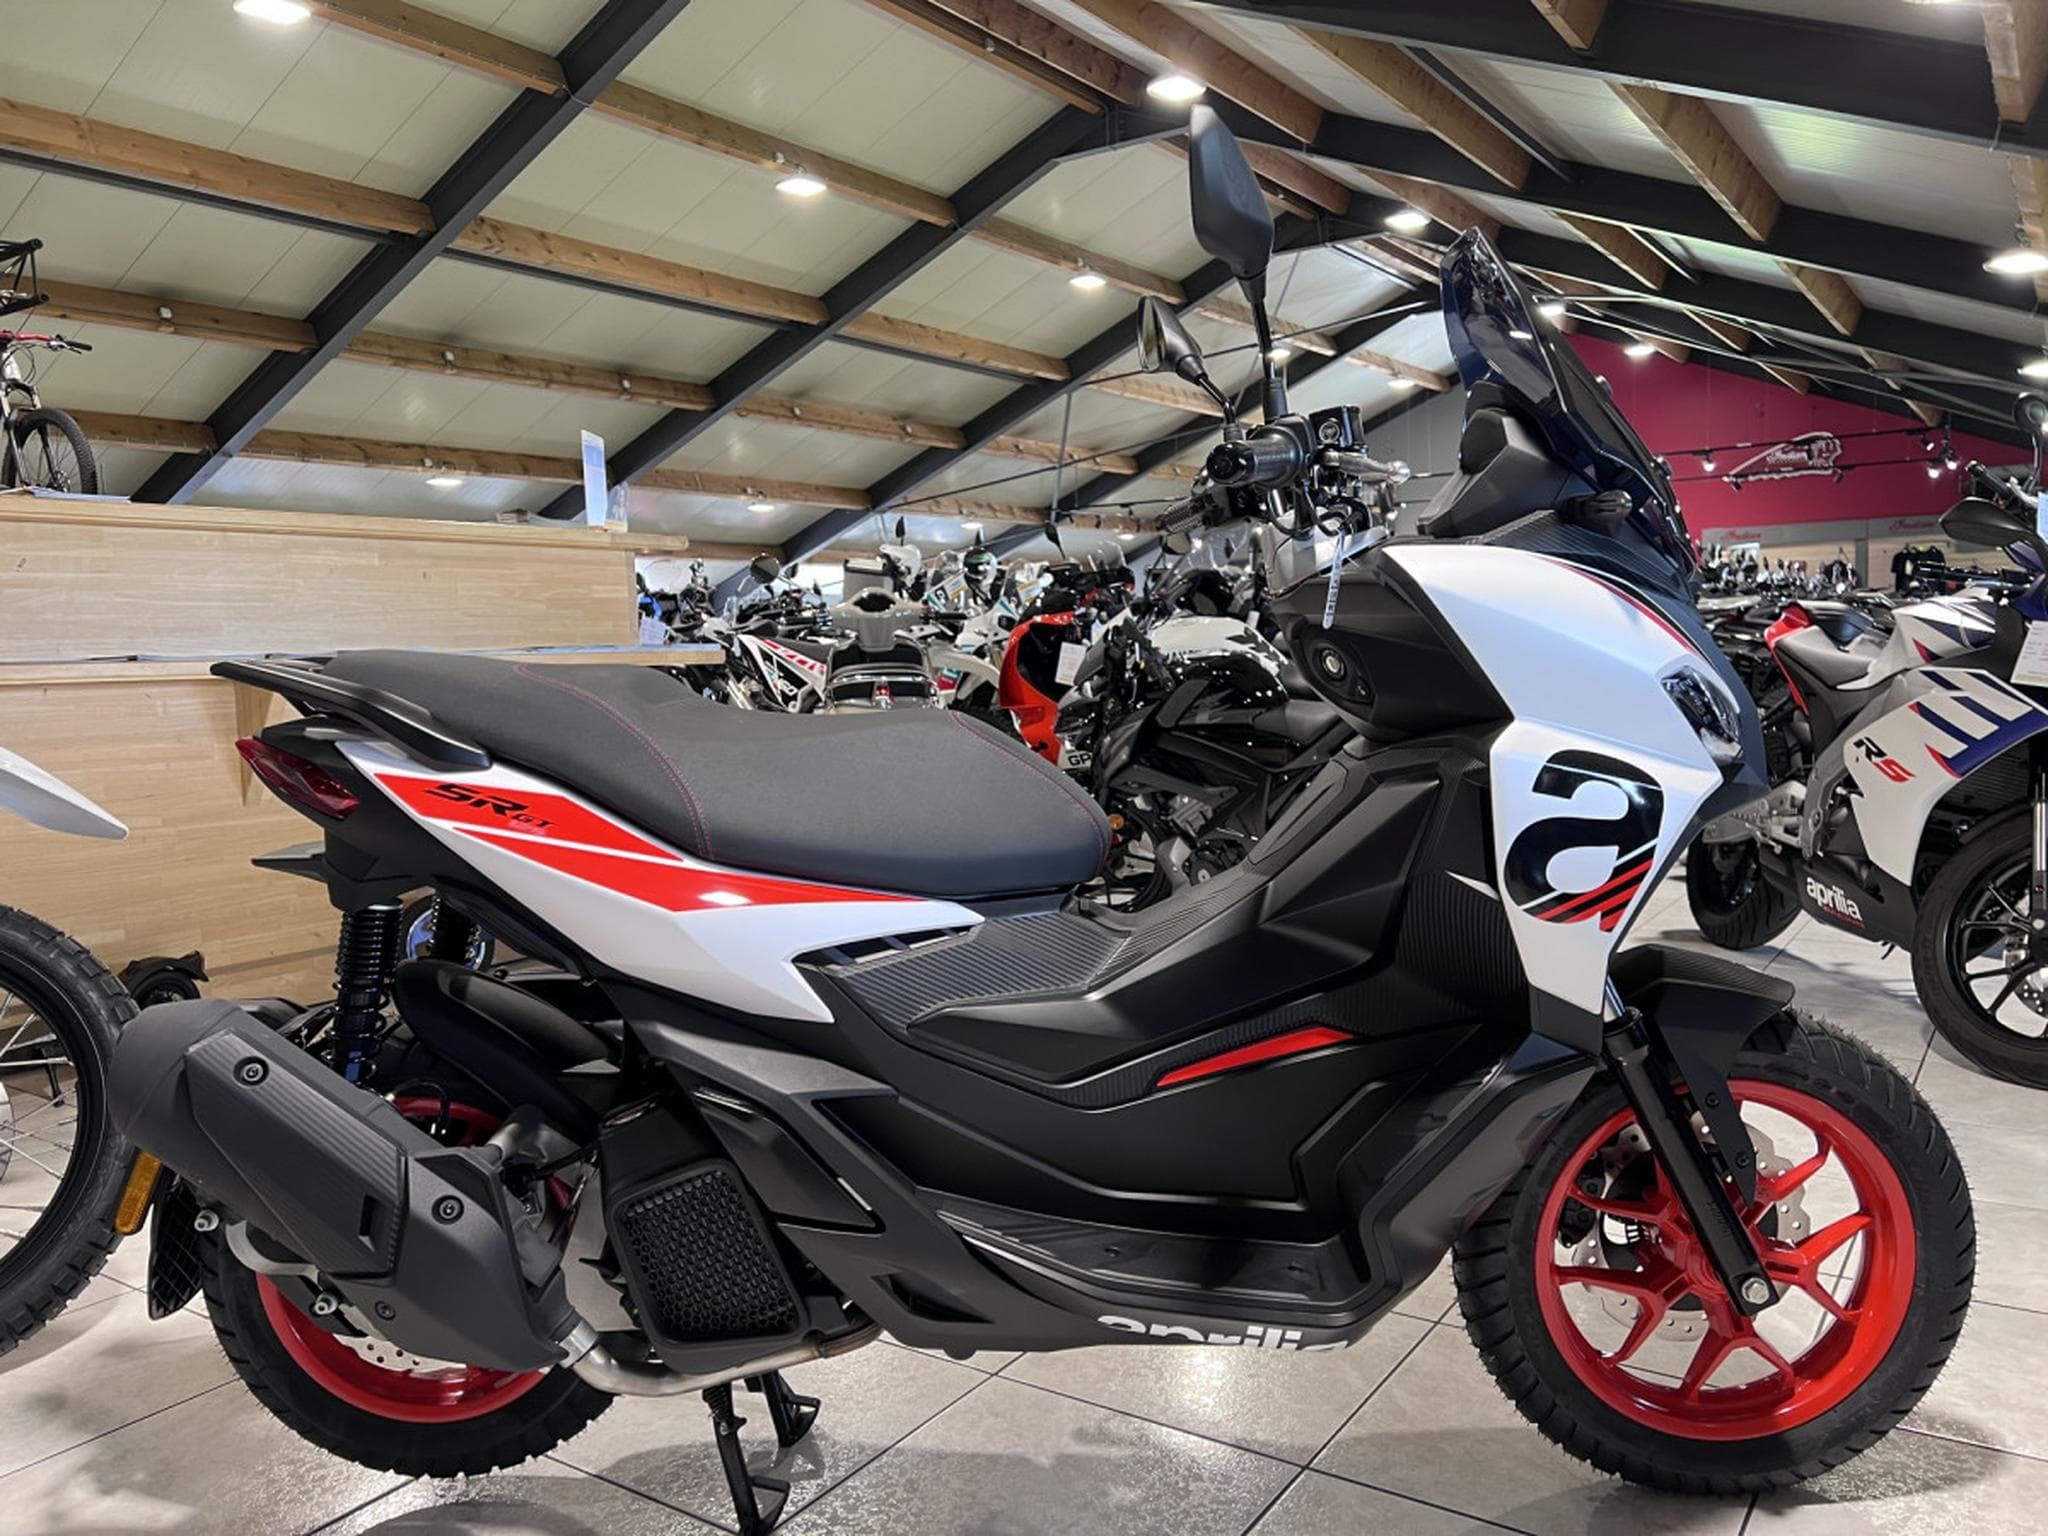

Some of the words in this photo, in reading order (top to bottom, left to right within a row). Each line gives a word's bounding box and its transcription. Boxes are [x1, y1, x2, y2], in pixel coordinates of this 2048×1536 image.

[1068, 752, 1092, 766] GP
[1853, 736, 1917, 783] RS
[424, 783, 529, 817] SR
[1805, 876, 1863, 921] aprilia
